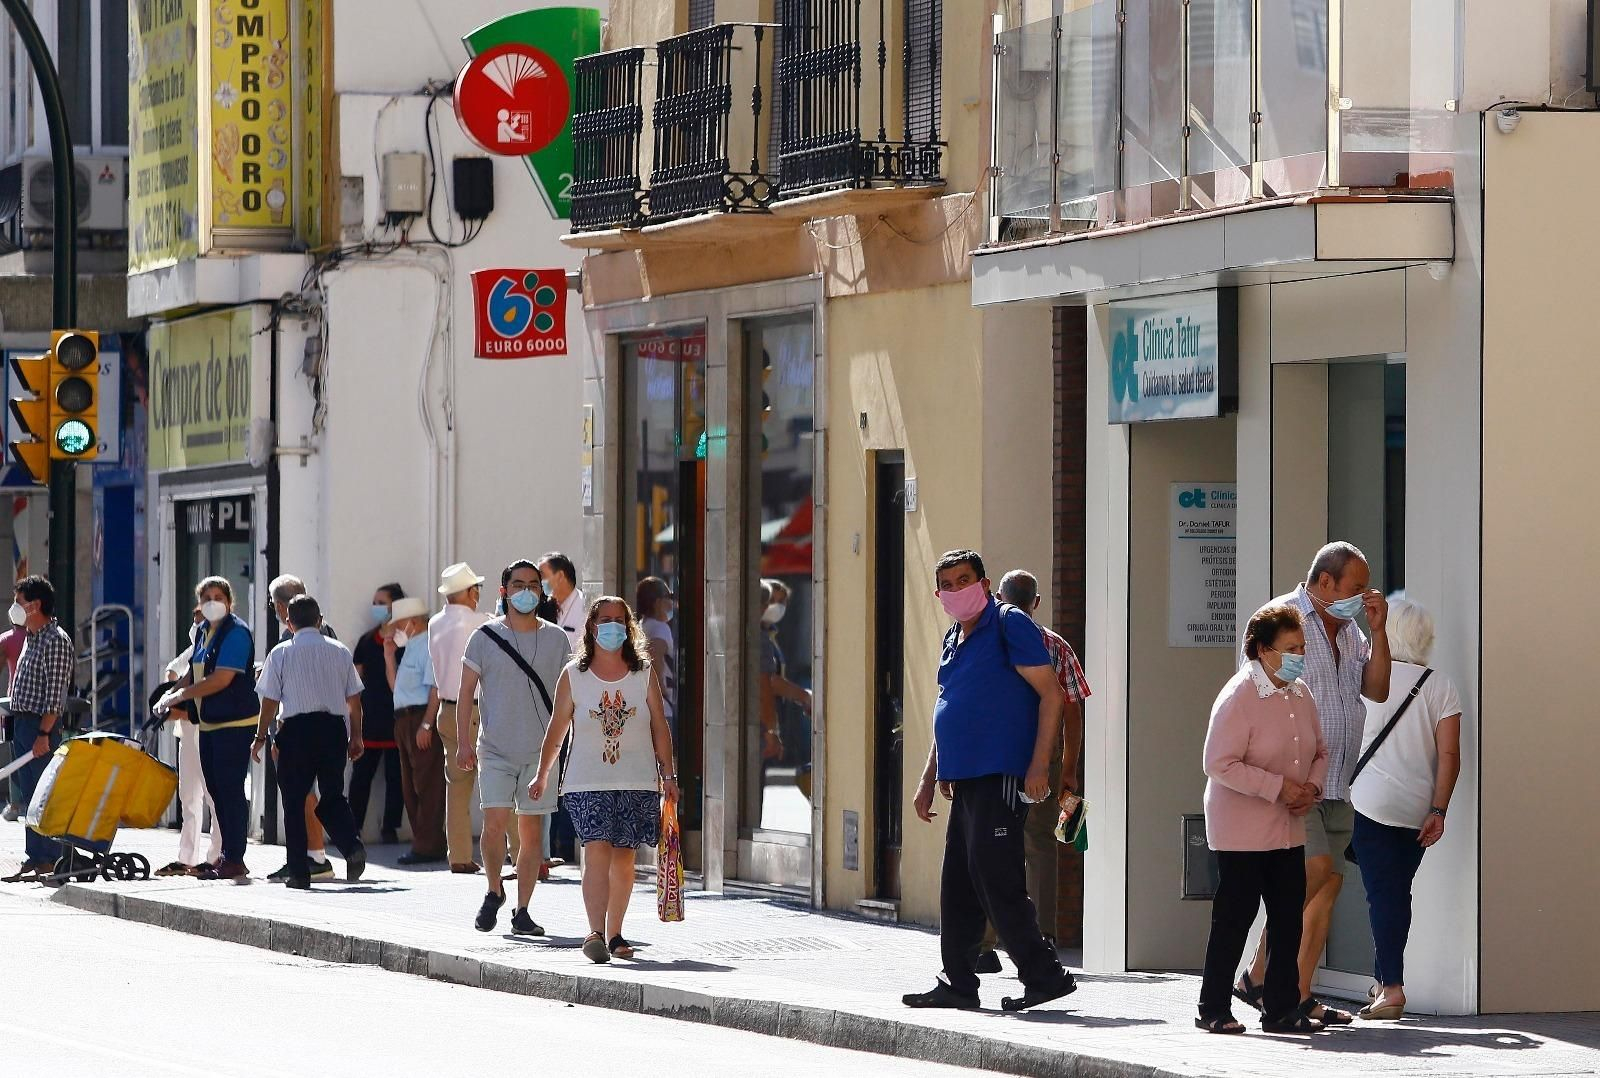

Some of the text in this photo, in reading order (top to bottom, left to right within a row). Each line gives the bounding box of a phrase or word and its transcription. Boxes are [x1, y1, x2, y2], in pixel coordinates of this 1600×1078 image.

[242, 133, 262, 212] ORO
[485, 338, 565, 353] EURO 6000
[1143, 315, 1200, 361] Clínica Tafur
[1143, 364, 1214, 398] Cuidamos tu salud dental
[153, 336, 248, 444] Compra de oro
[219, 501, 249, 530] PL
[1200, 546, 1230, 554] URGENCIAS
[1202, 555, 1228, 565] PRÓTESIS
[1205, 578, 1230, 587] ESTÉTICA
[1210, 623, 1224, 631] ORAL
[1194, 634, 1225, 642] IMPLANTES
